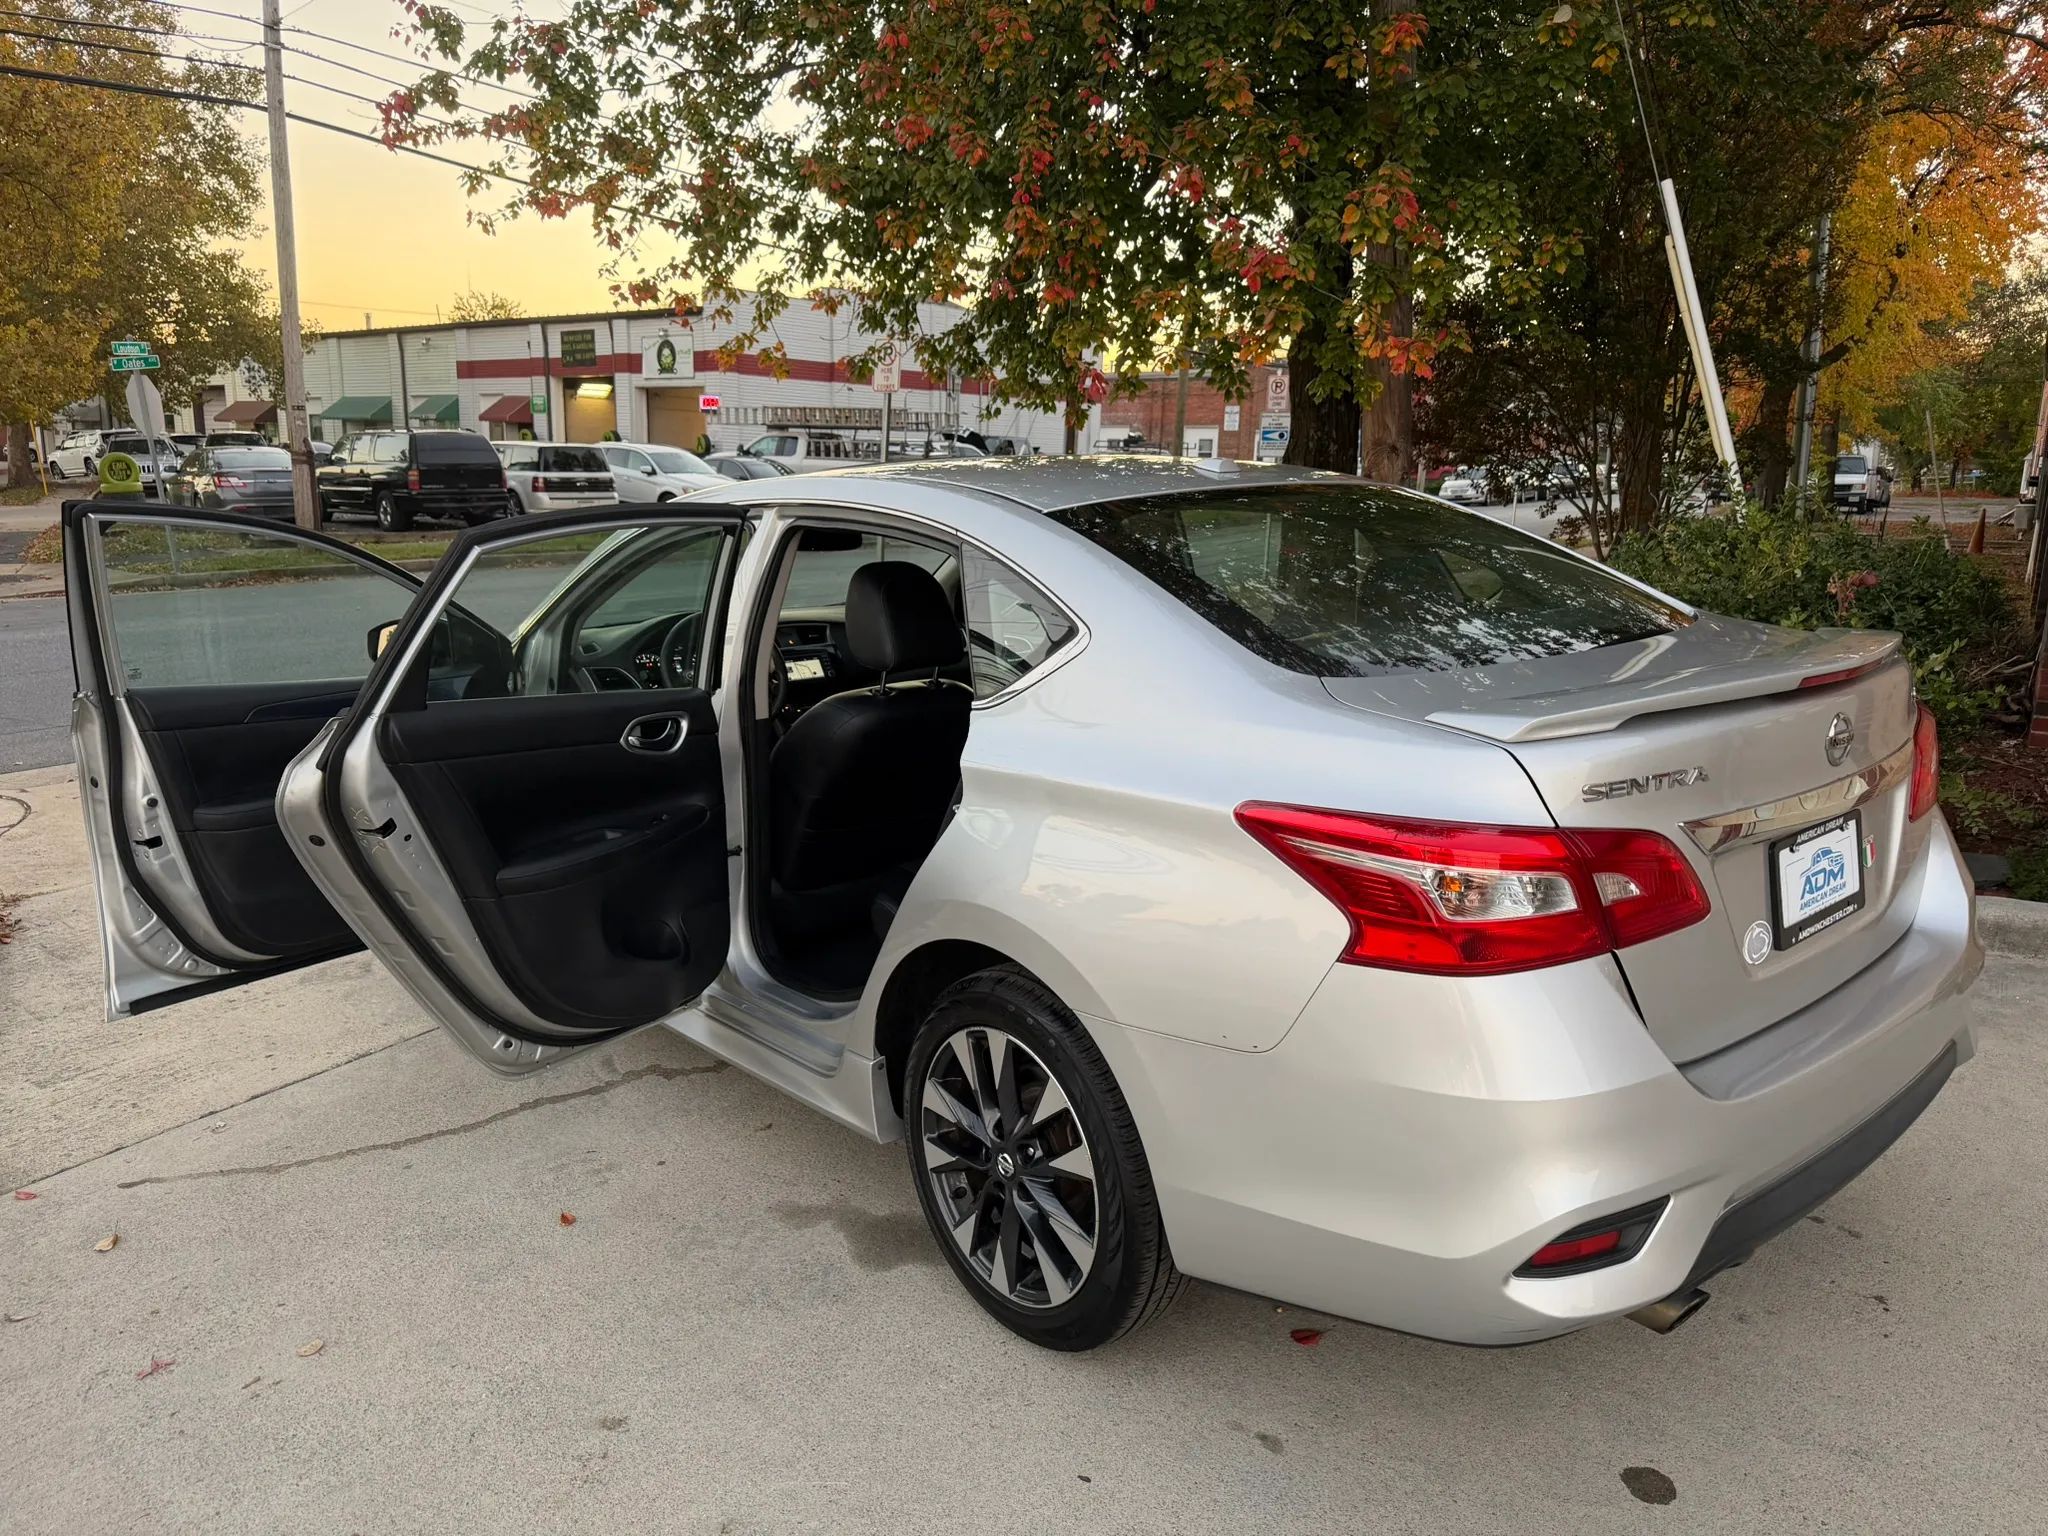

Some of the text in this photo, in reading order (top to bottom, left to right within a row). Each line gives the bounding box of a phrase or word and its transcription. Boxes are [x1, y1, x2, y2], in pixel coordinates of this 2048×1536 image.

[122, 359, 146, 368] Oates
[1582, 766, 1711, 803] SENTRA
[1796, 816, 1844, 844] AMERICAN DREAM
[1800, 862, 1844, 900] ADM
[1800, 891, 1828, 911] AMERICAN
[1829, 881, 1846, 896] DREAM
